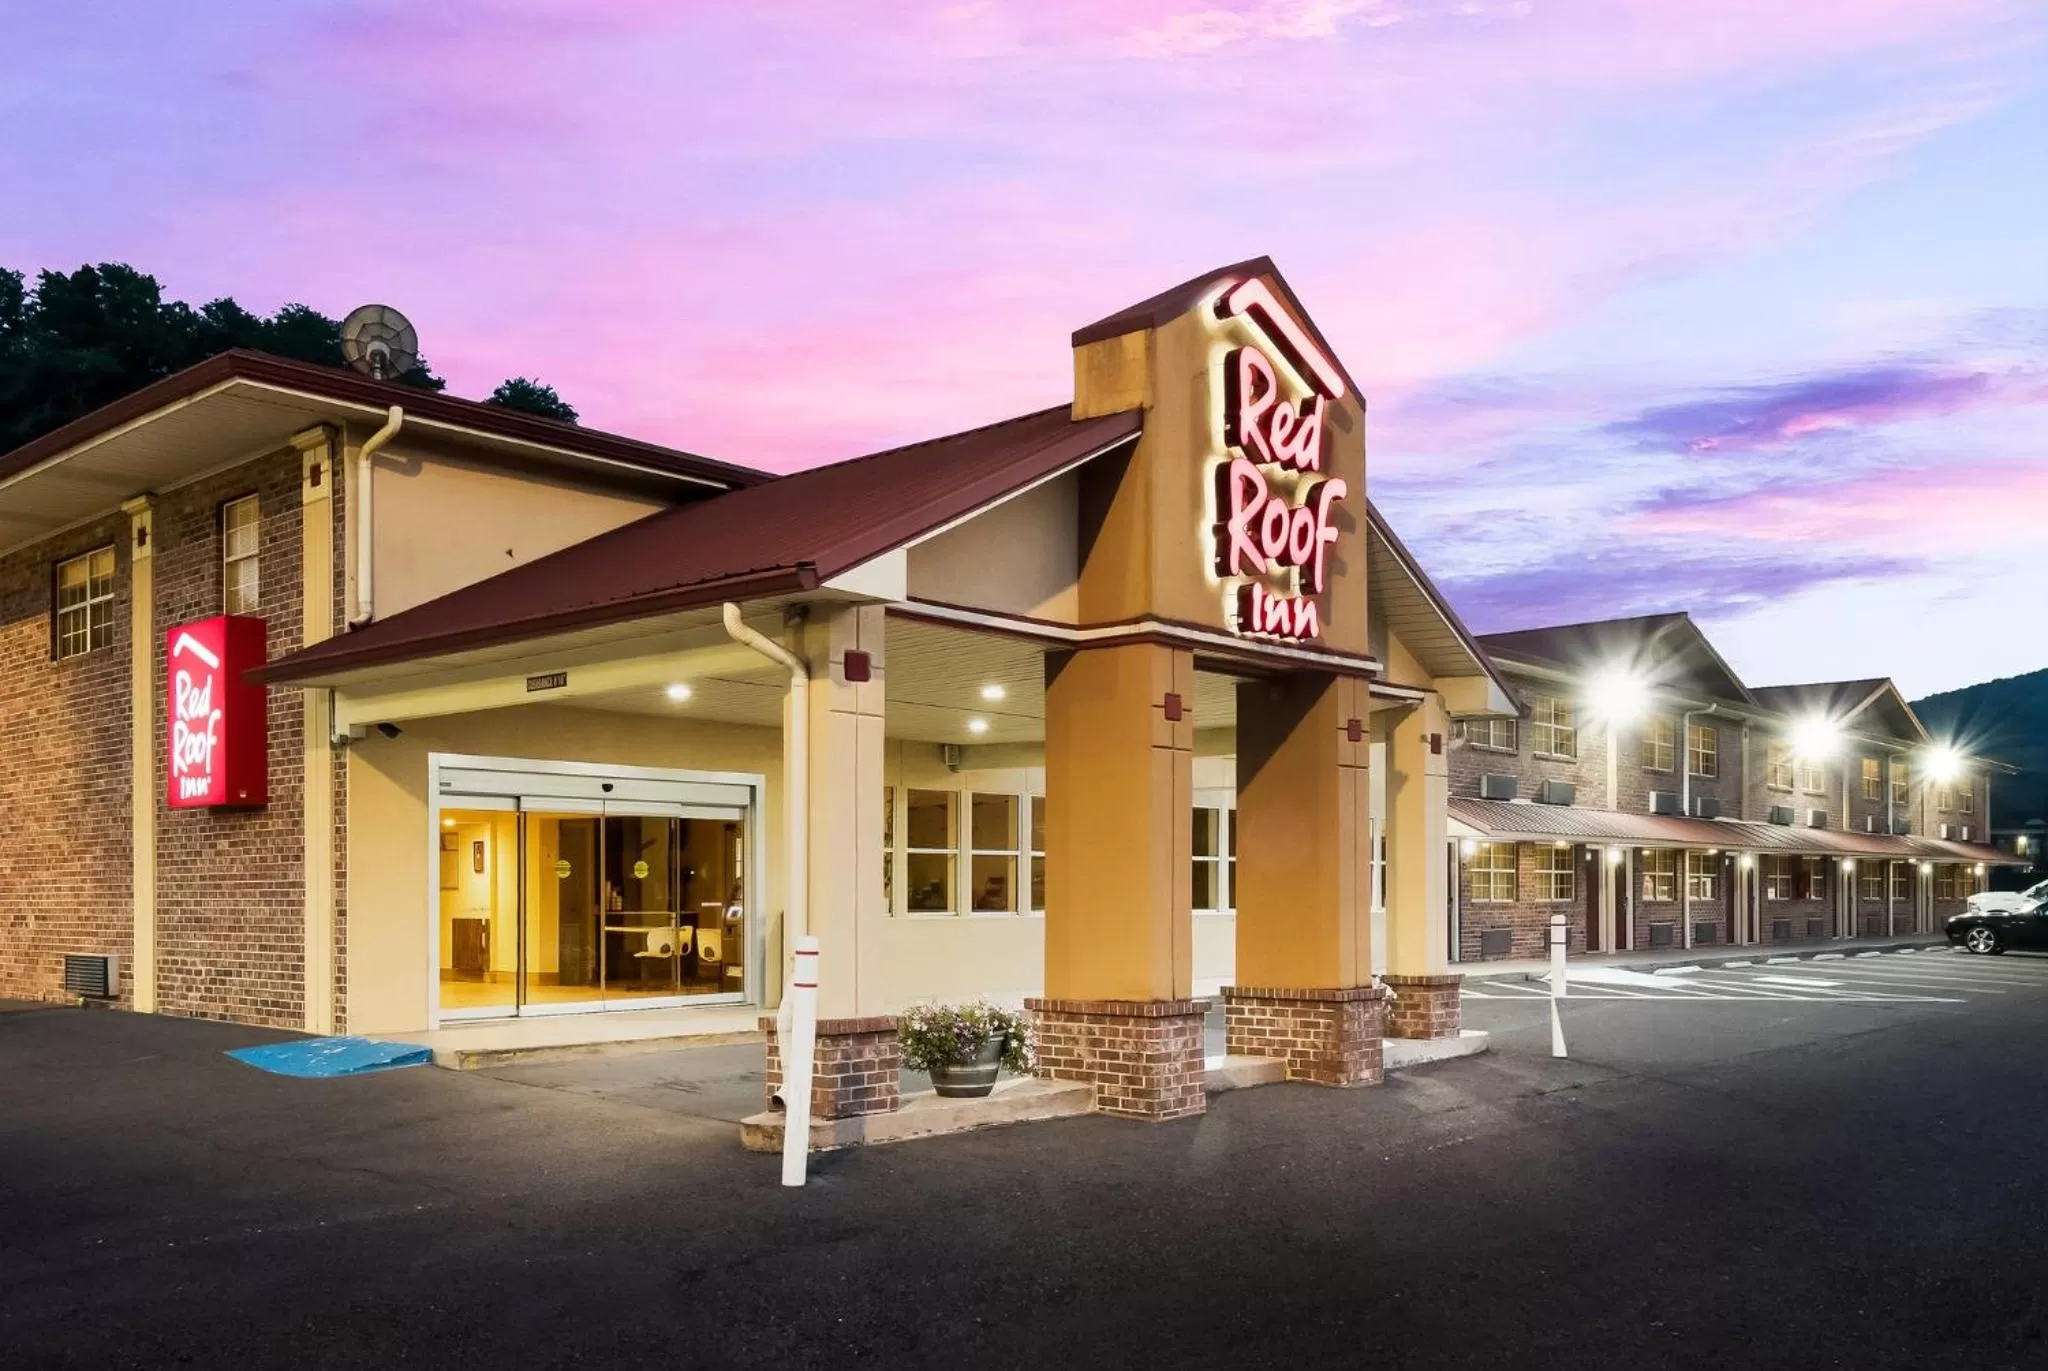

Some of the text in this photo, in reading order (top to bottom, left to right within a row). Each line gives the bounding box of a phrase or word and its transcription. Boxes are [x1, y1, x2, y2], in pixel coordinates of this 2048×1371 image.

[1238, 345, 1326, 472] Red
[1228, 456, 1348, 594] Roof
[1252, 581, 1320, 638] Inn
[175, 669, 213, 722] Red
[172, 708, 222, 778] Roof
